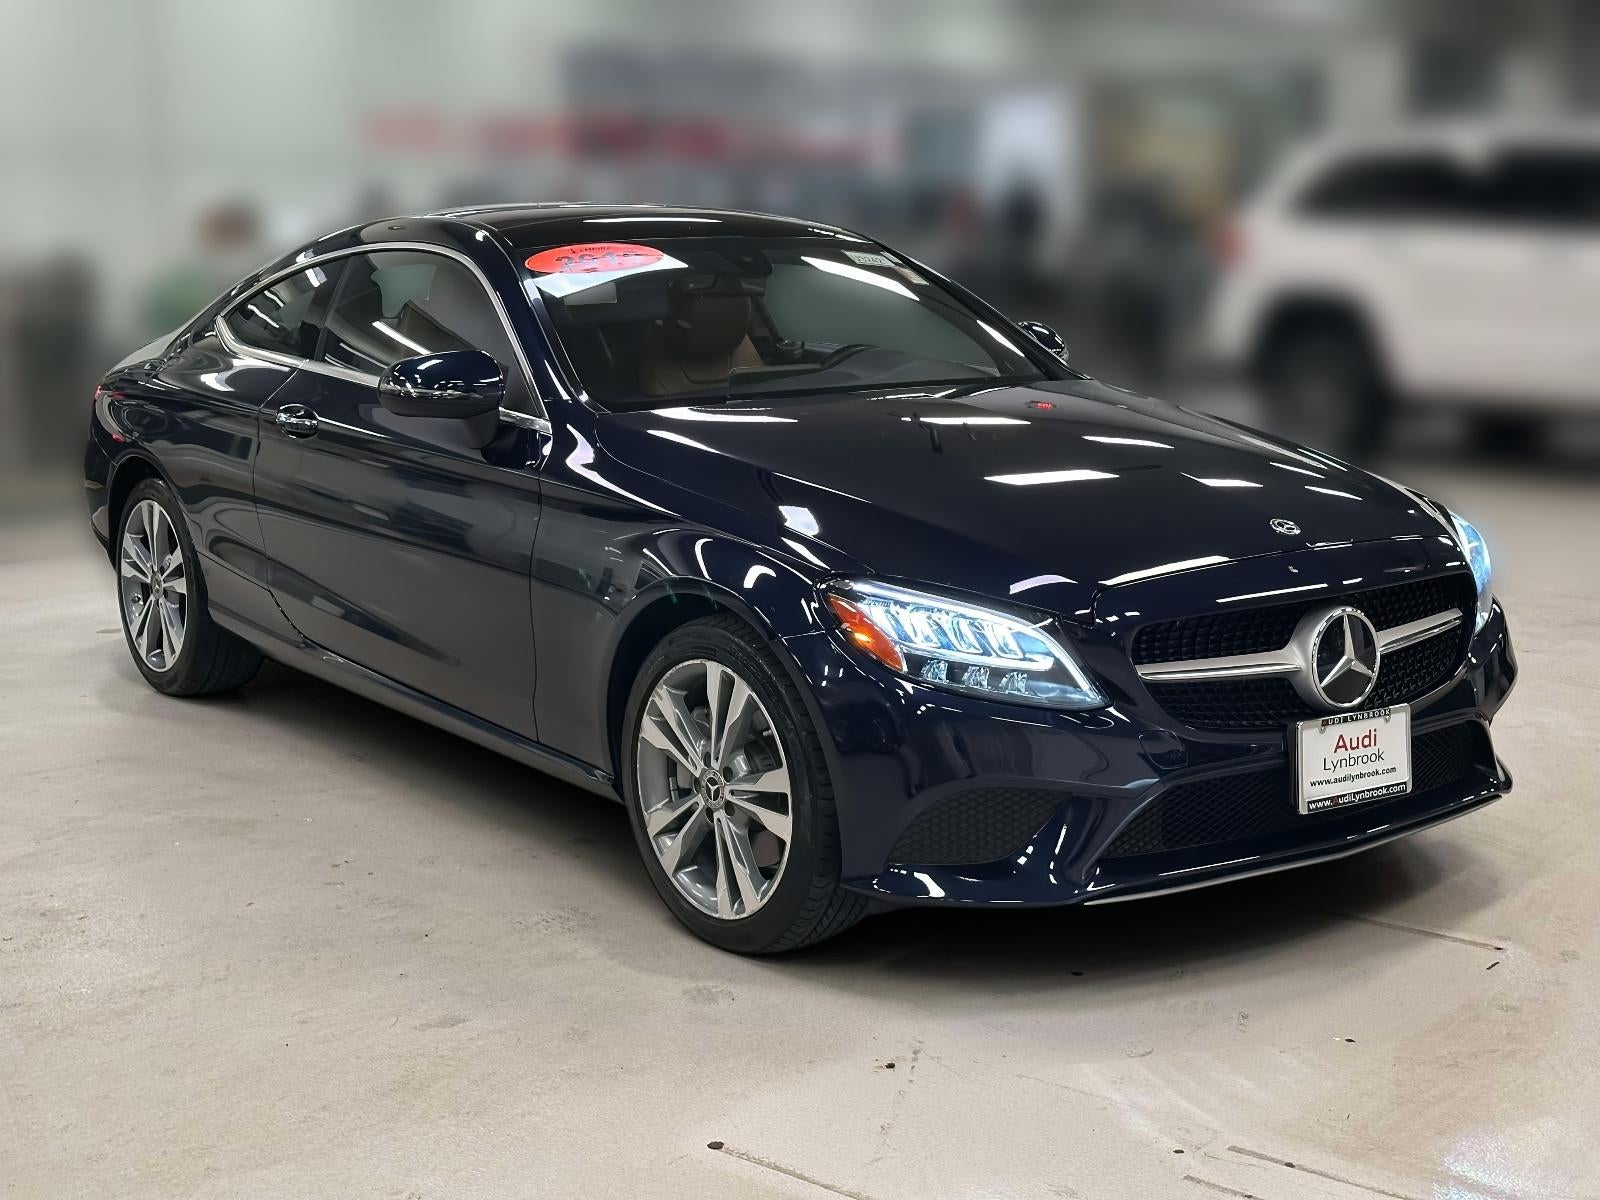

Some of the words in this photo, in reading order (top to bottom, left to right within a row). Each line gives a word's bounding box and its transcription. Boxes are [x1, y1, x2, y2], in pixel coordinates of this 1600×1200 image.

[1347, 708, 1390, 722] LYNBROOK
[1333, 728, 1377, 754] Audi
[1323, 748, 1385, 773] Lynbrook
[1309, 766, 1397, 787] www.audilynbrook.com
[1308, 784, 1406, 810] www.AudiLynbrook.com
